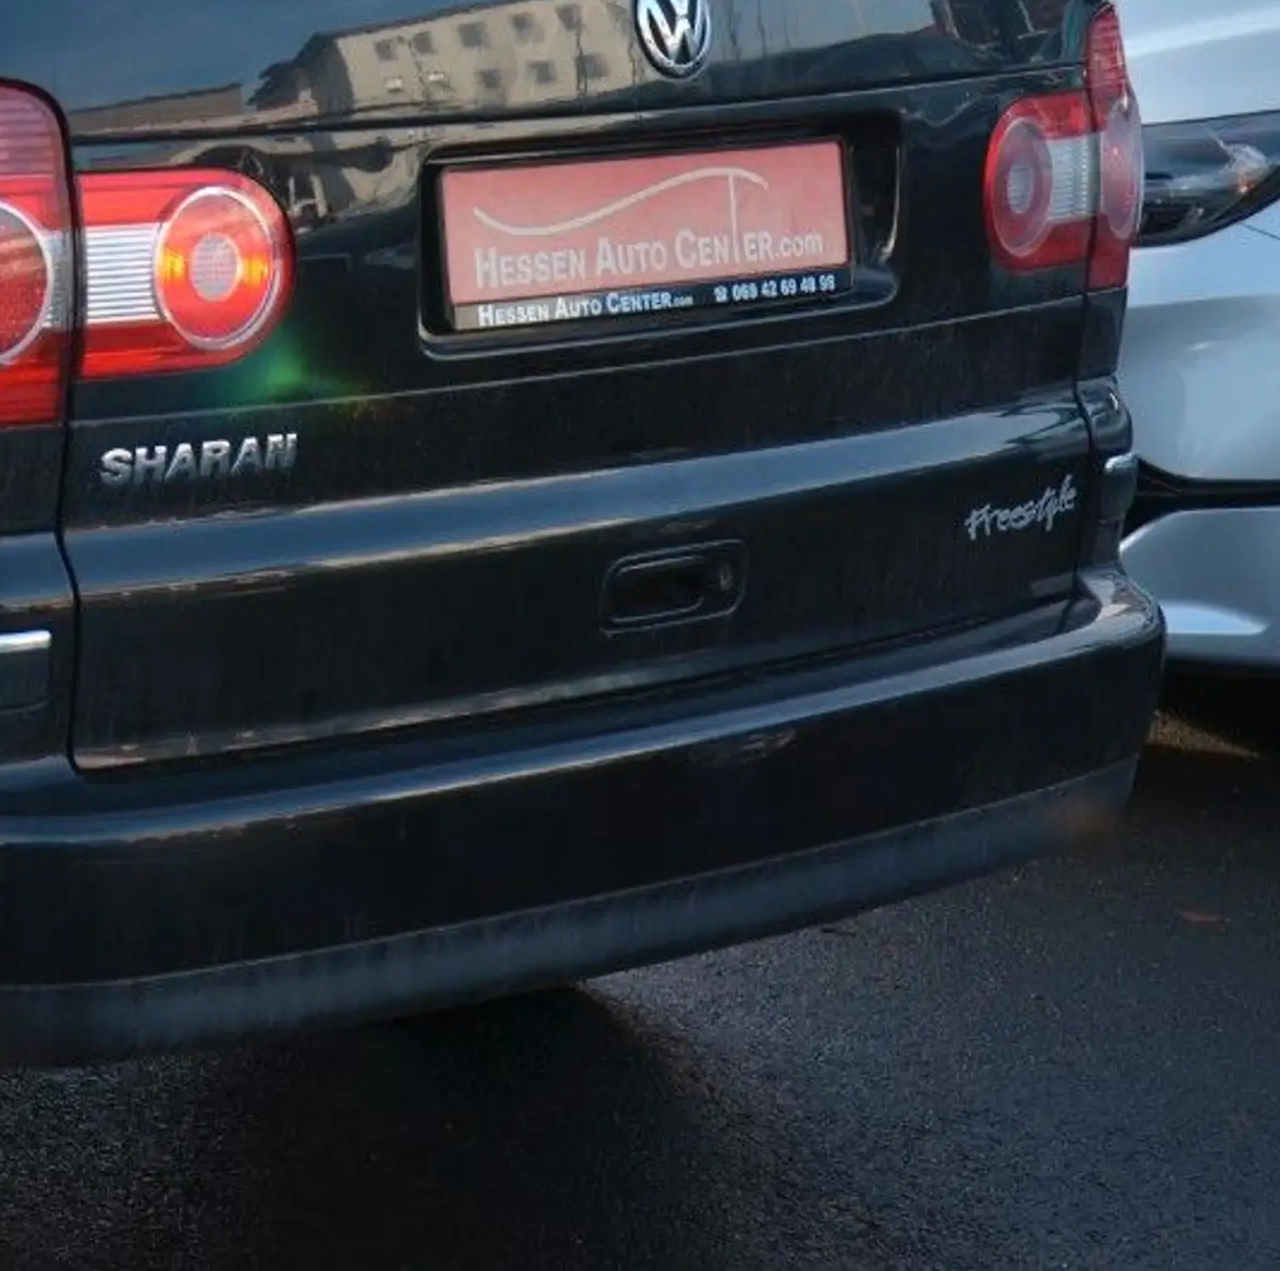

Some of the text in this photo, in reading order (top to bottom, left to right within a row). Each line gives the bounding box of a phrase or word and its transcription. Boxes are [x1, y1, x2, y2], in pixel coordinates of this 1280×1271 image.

[473, 246, 587, 289] HESSEN
[596, 236, 668, 276] AUTO
[477, 304, 550, 328] HESSEN
[555, 296, 602, 320] AUTO
[99, 432, 299, 486] SHARAN
